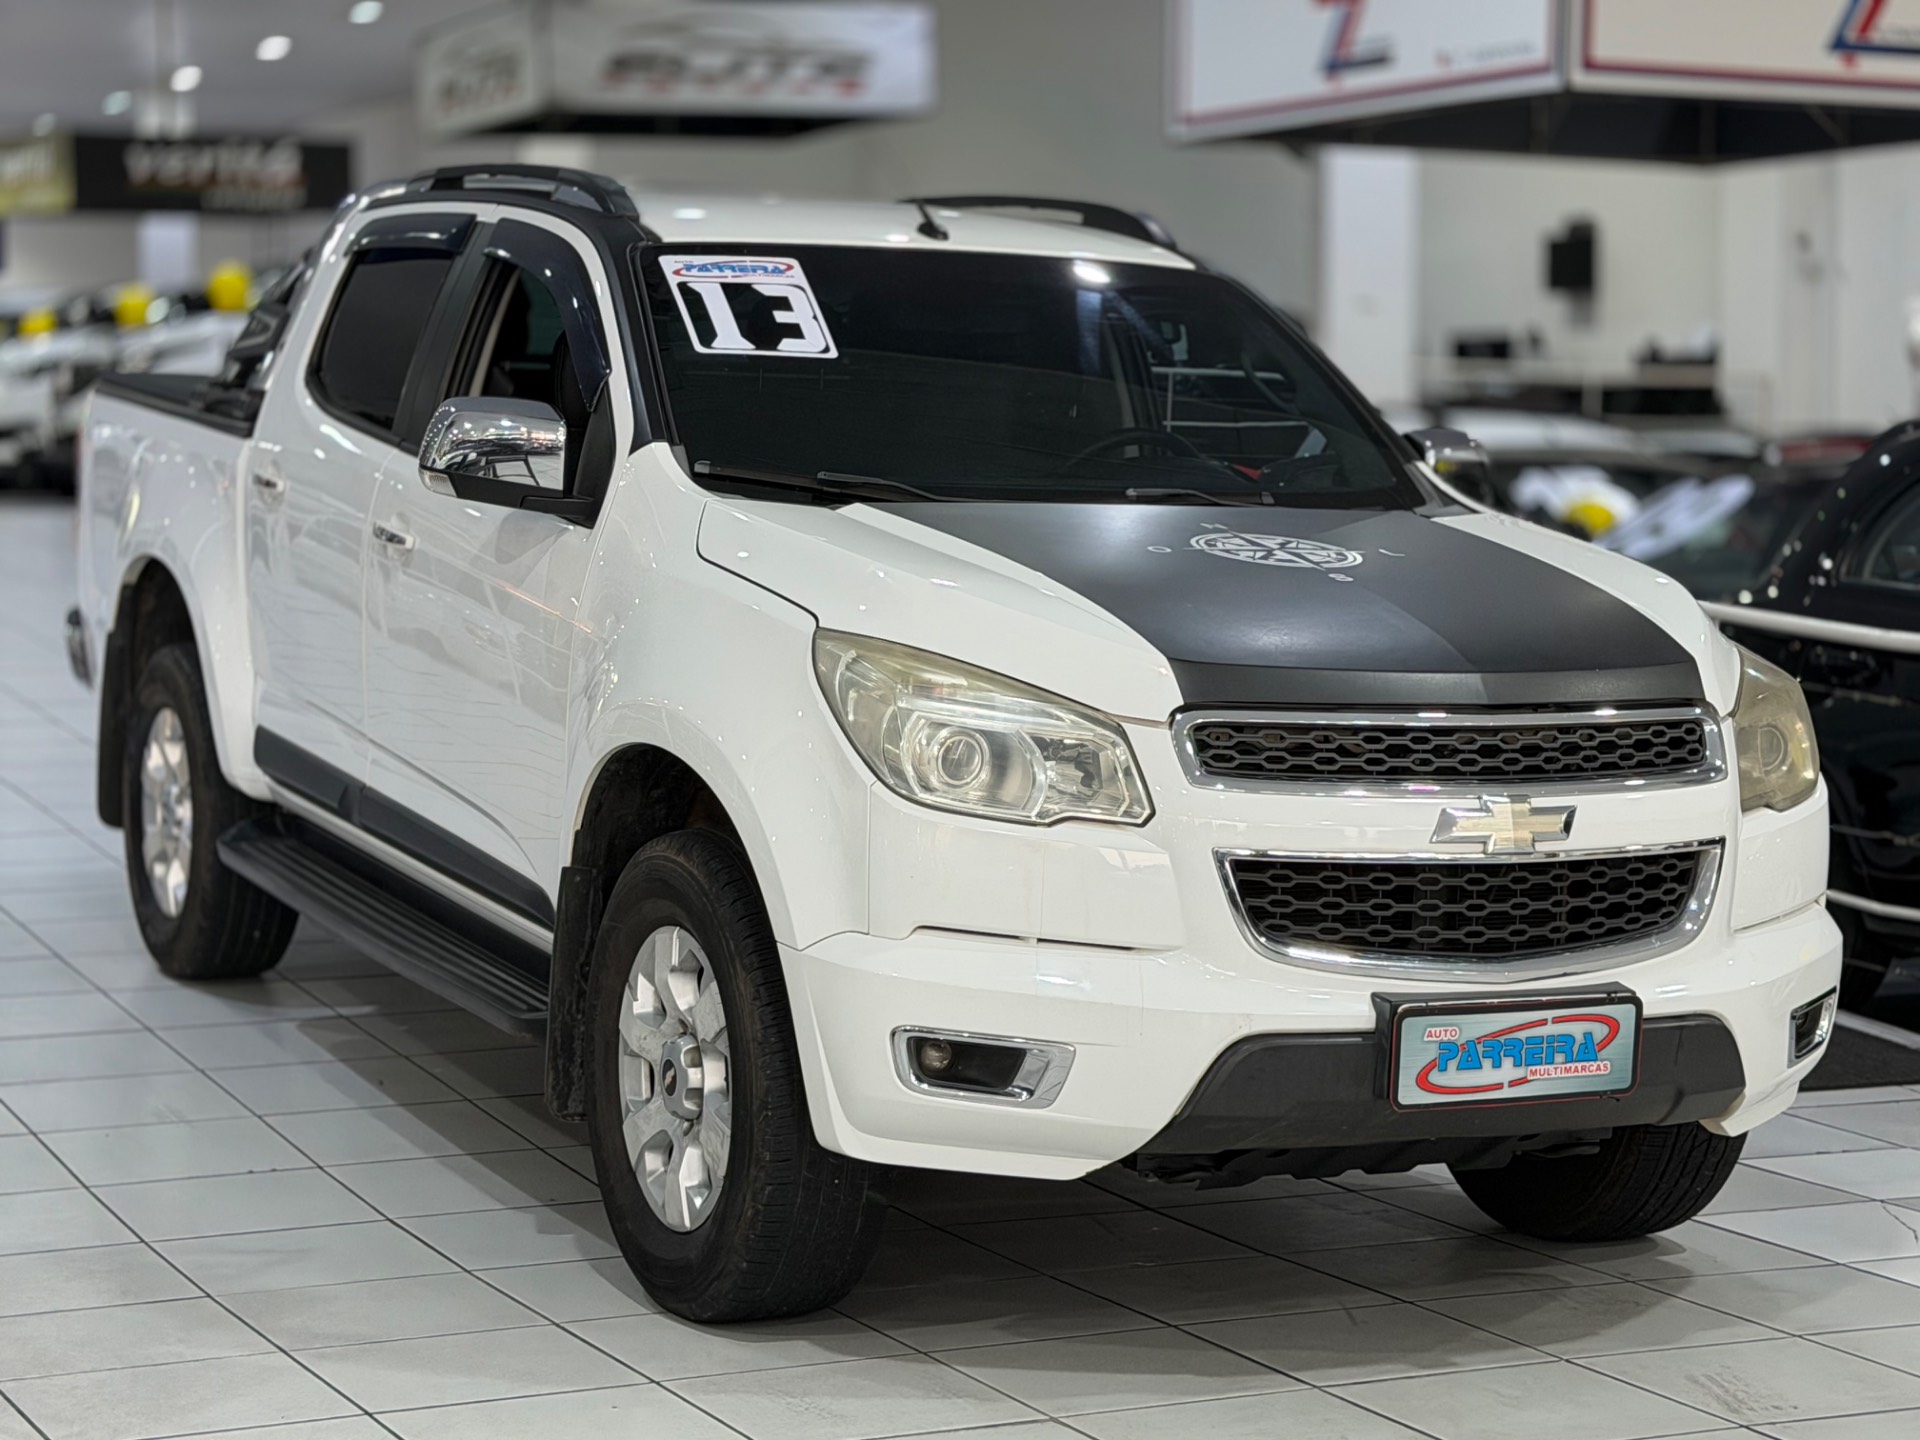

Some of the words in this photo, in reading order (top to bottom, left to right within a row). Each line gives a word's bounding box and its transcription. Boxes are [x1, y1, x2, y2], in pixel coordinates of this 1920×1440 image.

[686, 282, 828, 353] 13
[1425, 1028, 1458, 1040] AUTO
[1437, 1031, 1599, 1073] PARREIRA
[1528, 1062, 1610, 1078] MULTIMARCAS
